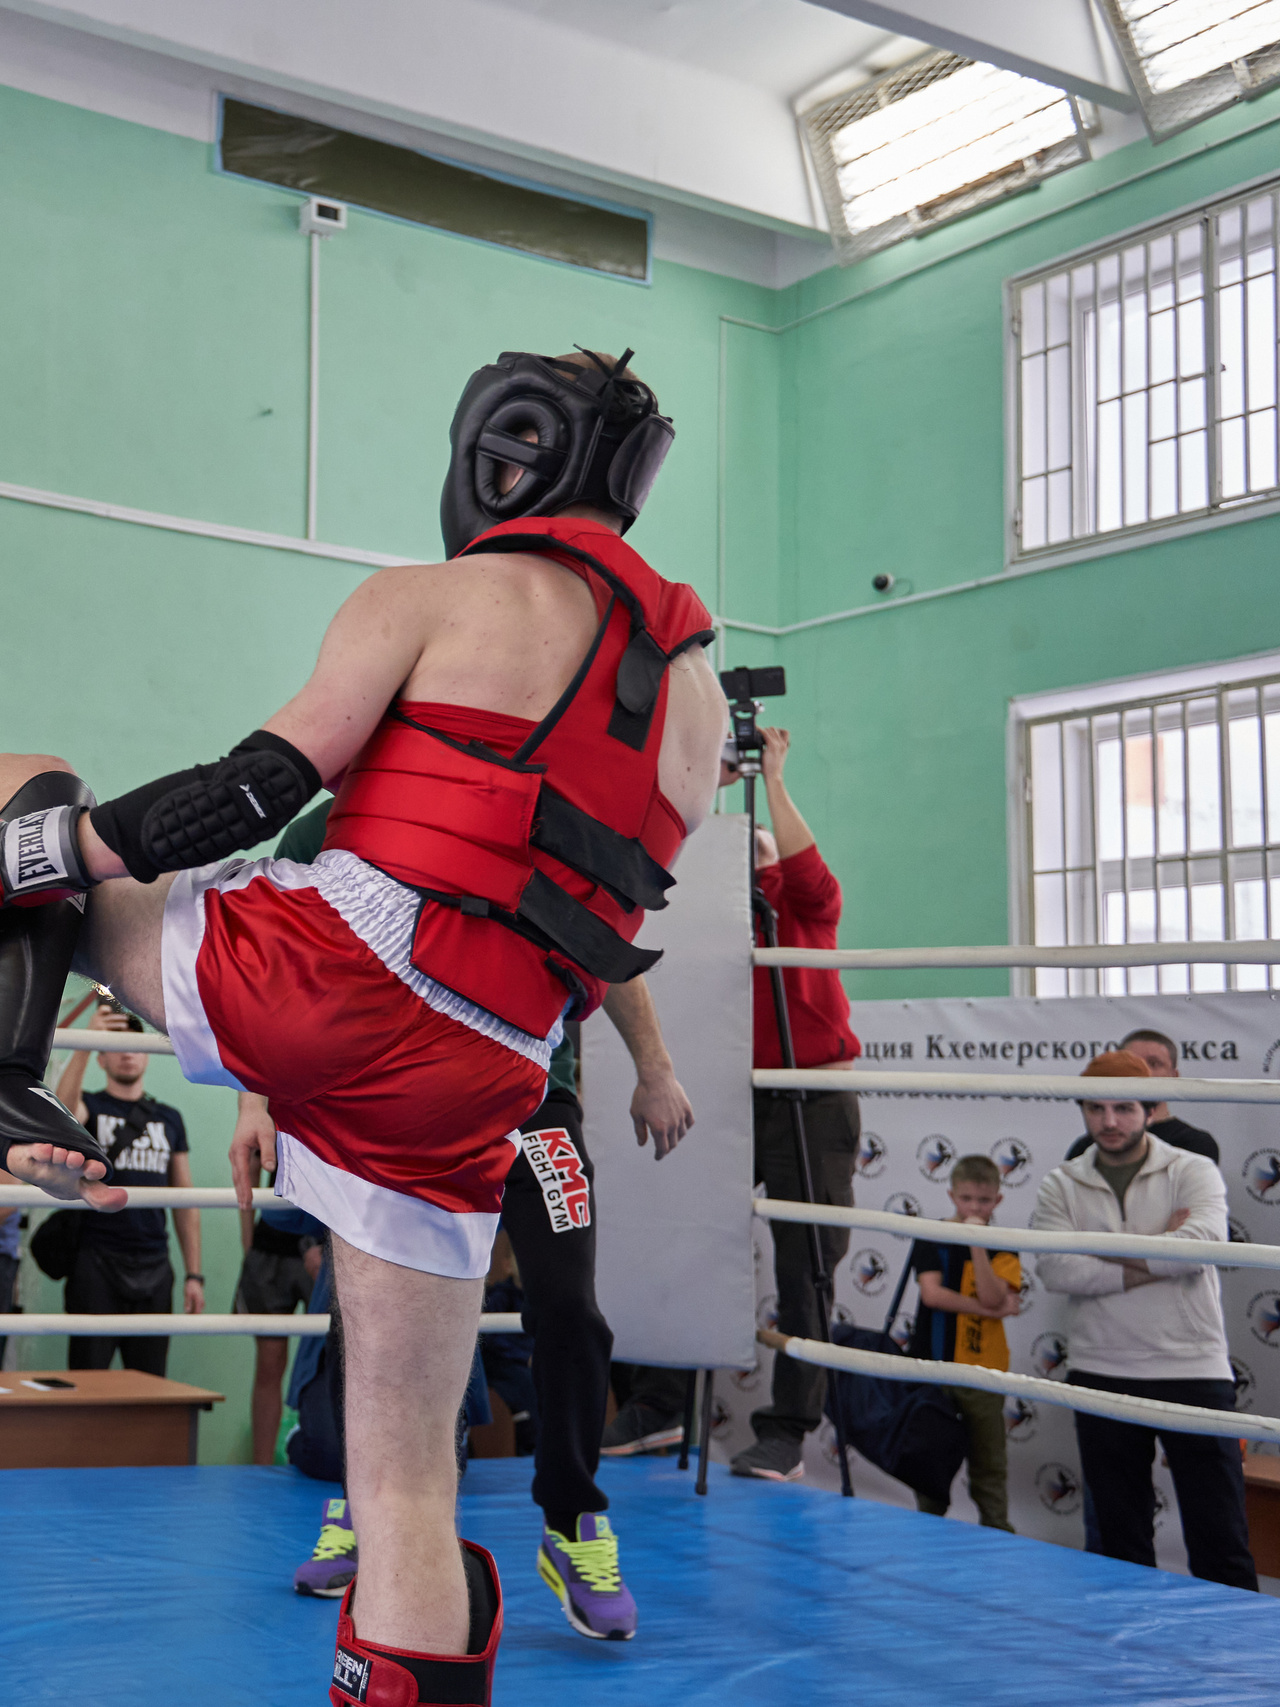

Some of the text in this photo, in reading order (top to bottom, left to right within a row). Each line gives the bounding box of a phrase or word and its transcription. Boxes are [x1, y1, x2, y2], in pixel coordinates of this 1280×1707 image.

[18, 808, 58, 885] EVERLAS
[859, 1041, 914, 1062] ция
[925, 1034, 1122, 1068] Кхемерского
[1180, 1040, 1239, 1061] кса
[96, 1113, 171, 1153] KCK
[522, 1135, 570, 1229] FIGHT GYM
[539, 1131, 590, 1226] KMC
[336, 1650, 363, 1677] REEN
